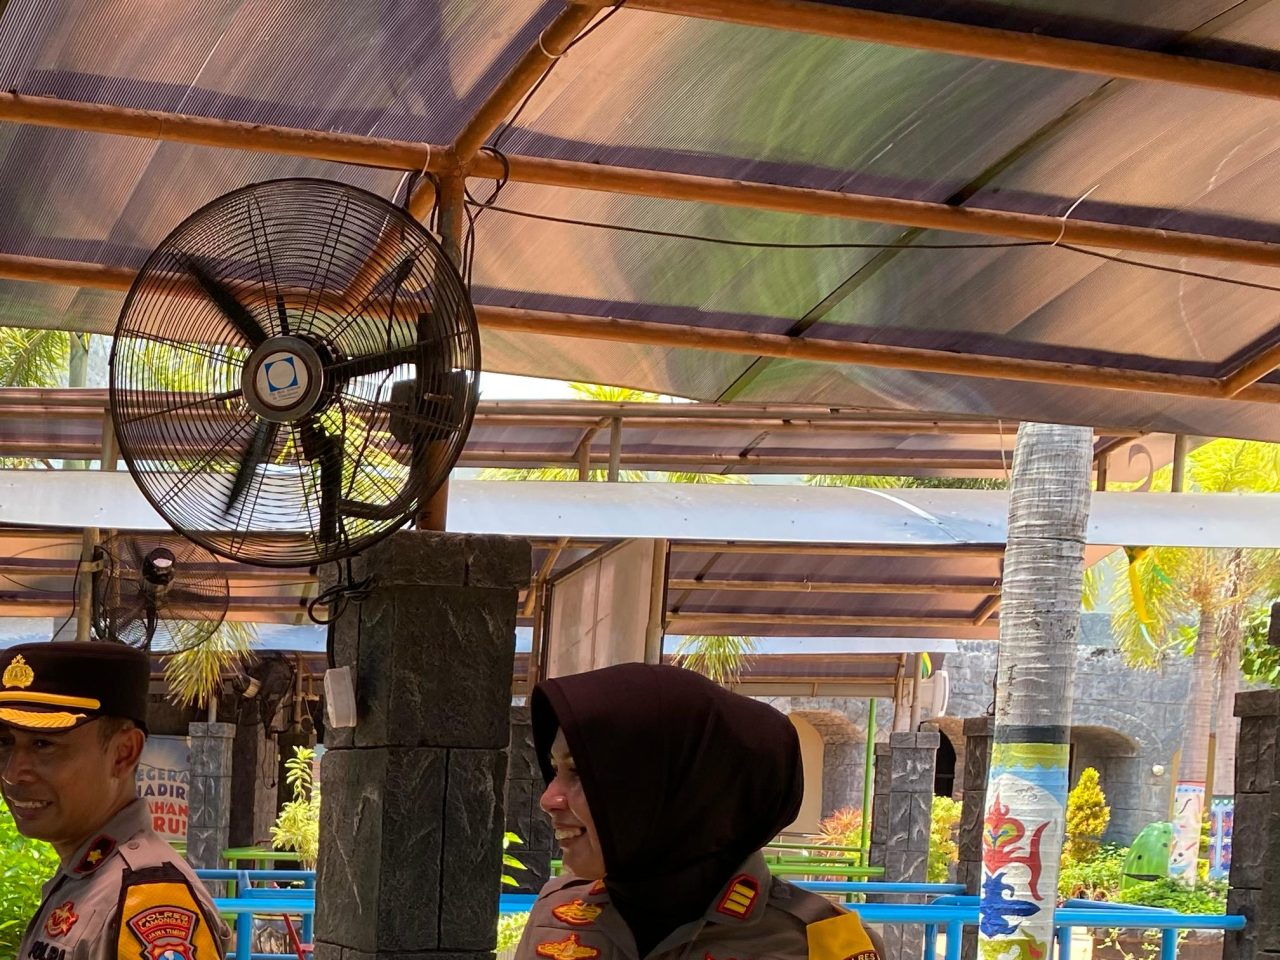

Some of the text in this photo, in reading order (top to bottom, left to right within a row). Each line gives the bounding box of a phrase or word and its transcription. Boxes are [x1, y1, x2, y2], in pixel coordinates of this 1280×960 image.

[136, 768, 190, 784] EGERA
[153, 816, 187, 836] RU!
[138, 912, 189, 924] POLRES
